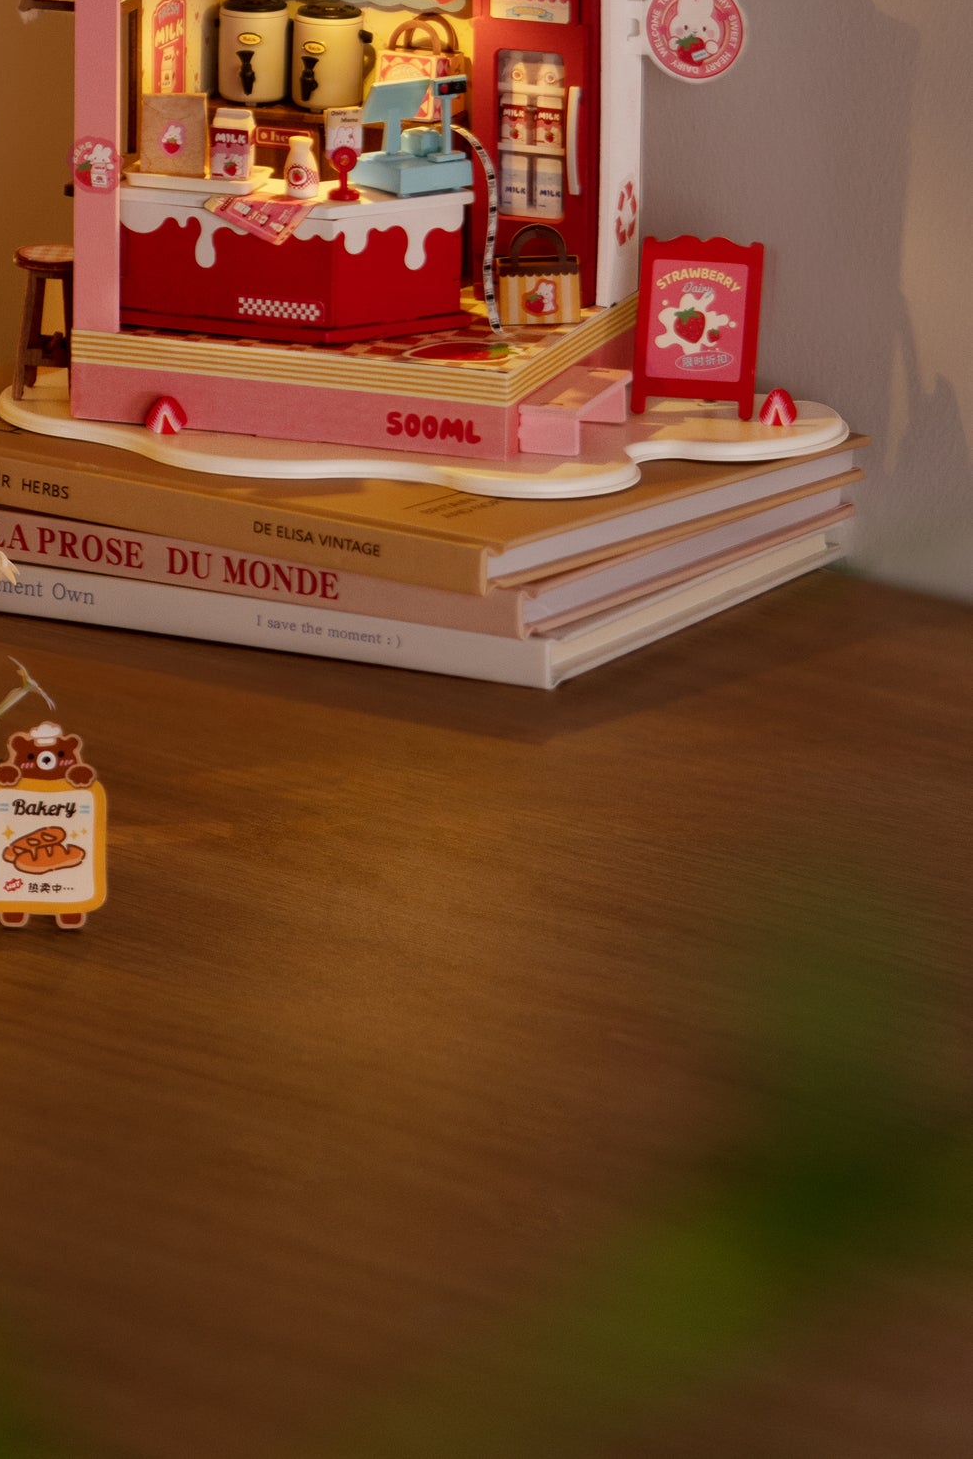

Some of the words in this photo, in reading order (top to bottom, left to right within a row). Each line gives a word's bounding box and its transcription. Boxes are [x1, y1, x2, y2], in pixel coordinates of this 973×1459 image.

[155, 19, 184, 47] MILK
[651, 9, 669, 57] WELCOME
[728, 14, 739, 49] SWEET
[670, 59, 699, 74] DAIRY
[704, 52, 731, 73] HEART
[503, 109, 525, 117] MILK
[538, 112, 560, 120] MILK
[215, 133, 246, 144] MILK
[505, 186, 526, 195] MILK
[540, 190, 561, 198] MILK
[656, 268, 741, 292] STRAWBERRY
[682, 282, 714, 299] Dairy
[21, 478, 70, 499] HERBS
[253, 521, 272, 534] DE
[276, 526, 314, 545] ELISA
[317, 534, 381, 558] VINTAGE
[36, 526, 145, 570] PROSE
[166, 546, 213, 580] DU
[222, 555, 340, 601] MONDE
[52, 582, 95, 606] Own
[256, 614, 262, 626] I
[267, 619, 297, 632] save
[301, 621, 323, 636] the
[327, 627, 382, 645] moment
[12, 799, 76, 818] Bakery
